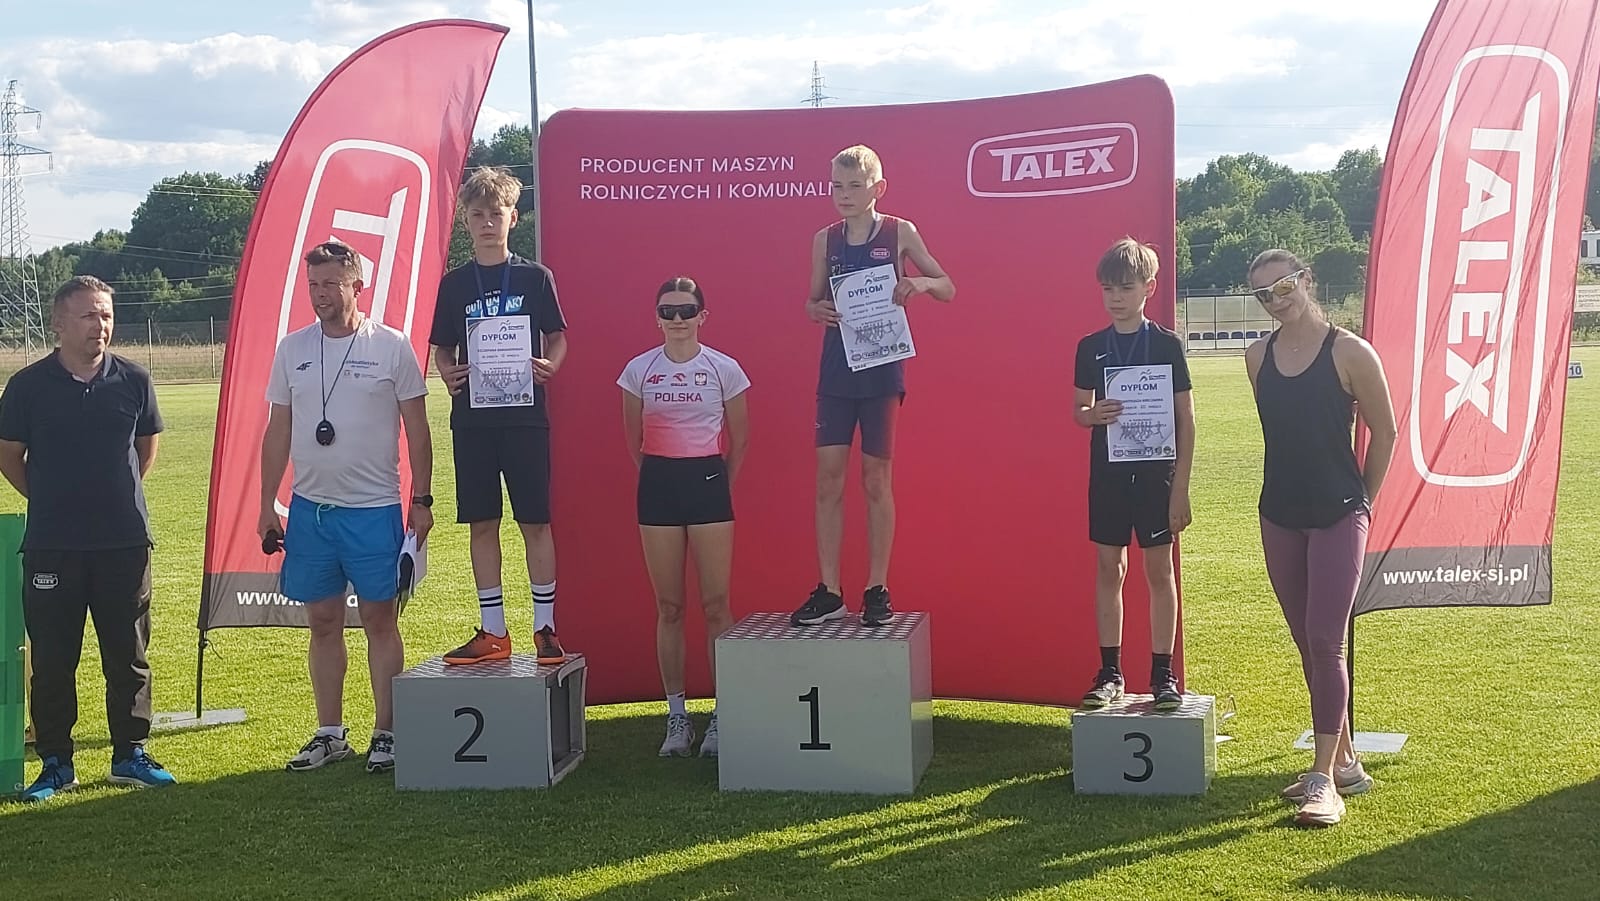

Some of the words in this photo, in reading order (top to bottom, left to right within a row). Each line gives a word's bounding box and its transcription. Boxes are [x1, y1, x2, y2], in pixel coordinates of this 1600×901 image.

[580, 157, 705, 174] PRODUCENT
[711, 156, 795, 173] MASZYN
[988, 135, 1121, 182] TALEX
[580, 184, 711, 201] ROLNICZYCH
[717, 184, 722, 199] I
[1444, 90, 1541, 434] TALEX
[848, 284, 883, 298] DYPLOM
[481, 333, 517, 342] DYPLOM
[1569, 365, 1582, 375] 10
[646, 374, 667, 385] 4F
[1120, 383, 1158, 392] DYPLOM
[655, 392, 703, 402] POLSKA
[1383, 563, 1529, 586] www.talex-sj.pl
[798, 686, 832, 751] 1
[454, 707, 488, 762] 2
[1123, 731, 1153, 783] 3
